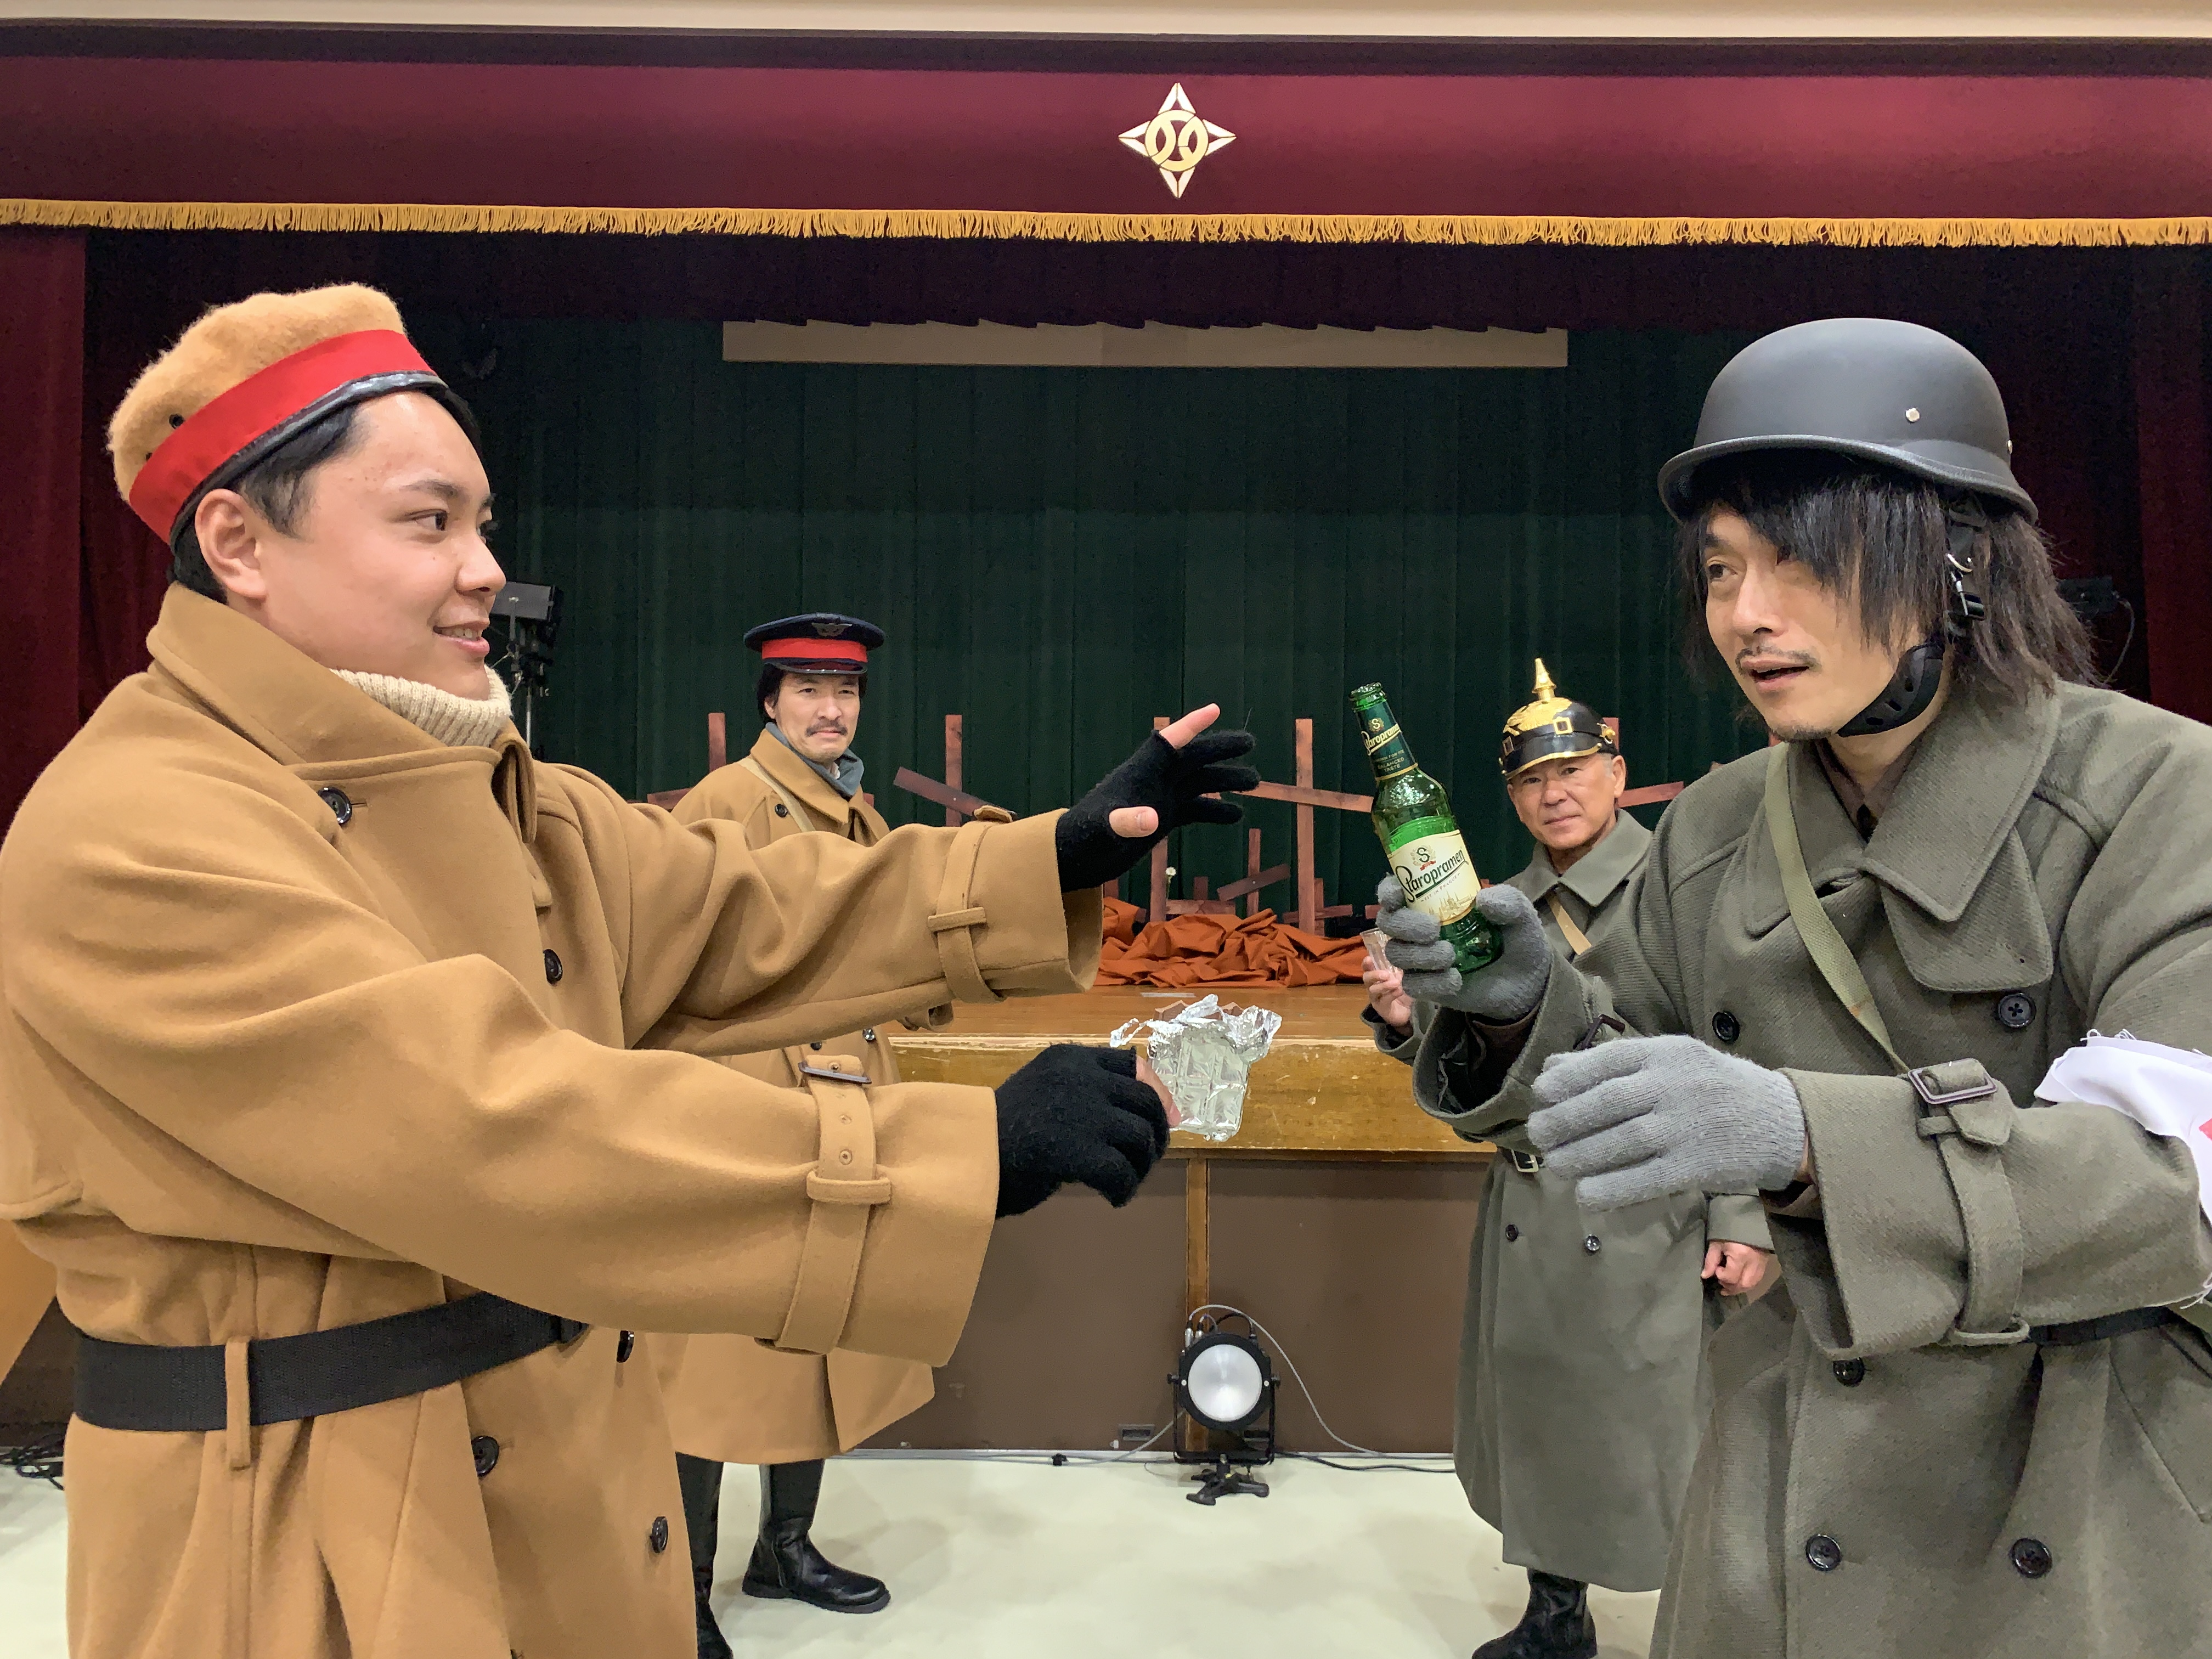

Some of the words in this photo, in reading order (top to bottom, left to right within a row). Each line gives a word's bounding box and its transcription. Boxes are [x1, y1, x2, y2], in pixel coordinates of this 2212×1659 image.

[1372, 719, 1381, 729] S
[1384, 764, 1400, 772] TASTE
[1416, 847, 1430, 862] S
[1395, 849, 1469, 903] Staropramen
